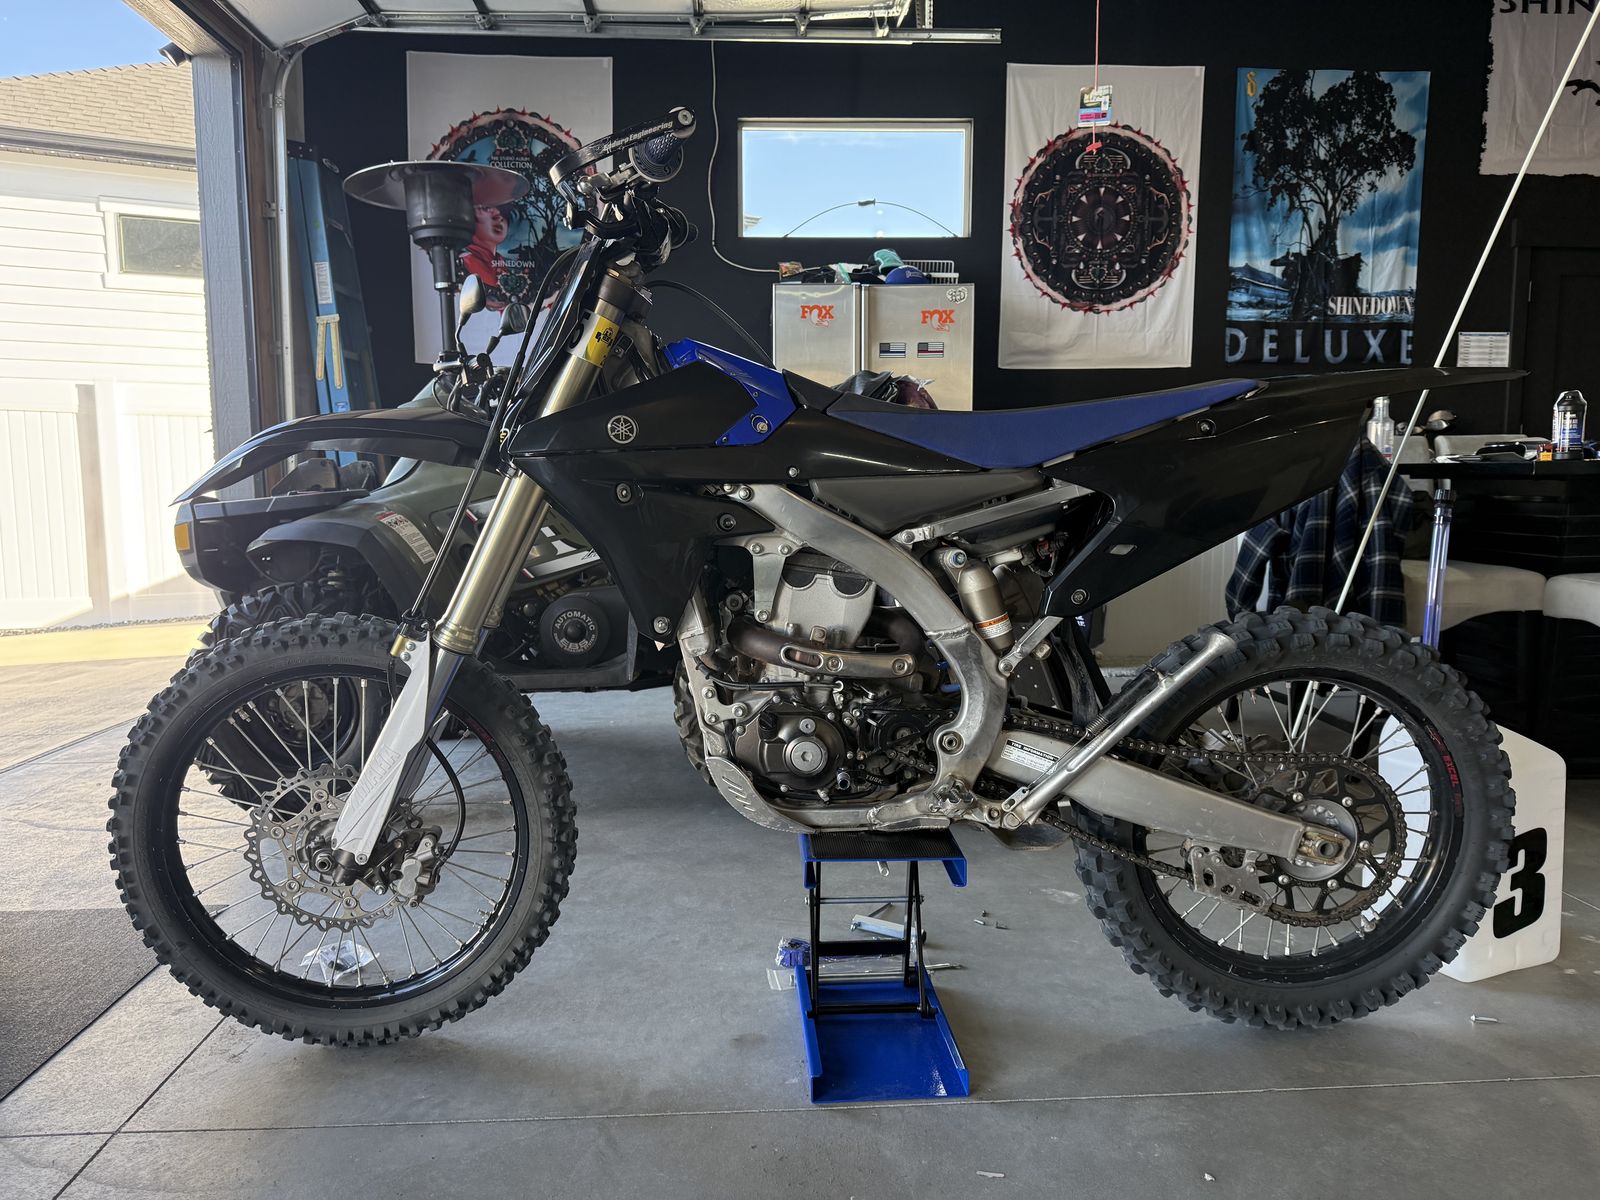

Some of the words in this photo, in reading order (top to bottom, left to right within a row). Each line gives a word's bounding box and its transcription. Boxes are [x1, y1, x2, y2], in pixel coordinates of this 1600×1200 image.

[629, 121, 673, 140] Engineering
[490, 160, 533, 169] COLLECTION
[491, 260, 536, 268] SHINEDOWN
[800, 304, 835, 320] FOX
[1327, 295, 1413, 317] SHINEDOWN
[920, 309, 956, 325] FOX
[1224, 326, 1414, 366] DELUXE
[554, 610, 596, 631] AUTOMATIC
[559, 637, 590, 650] EBS
[1493, 827, 1548, 939] 3
